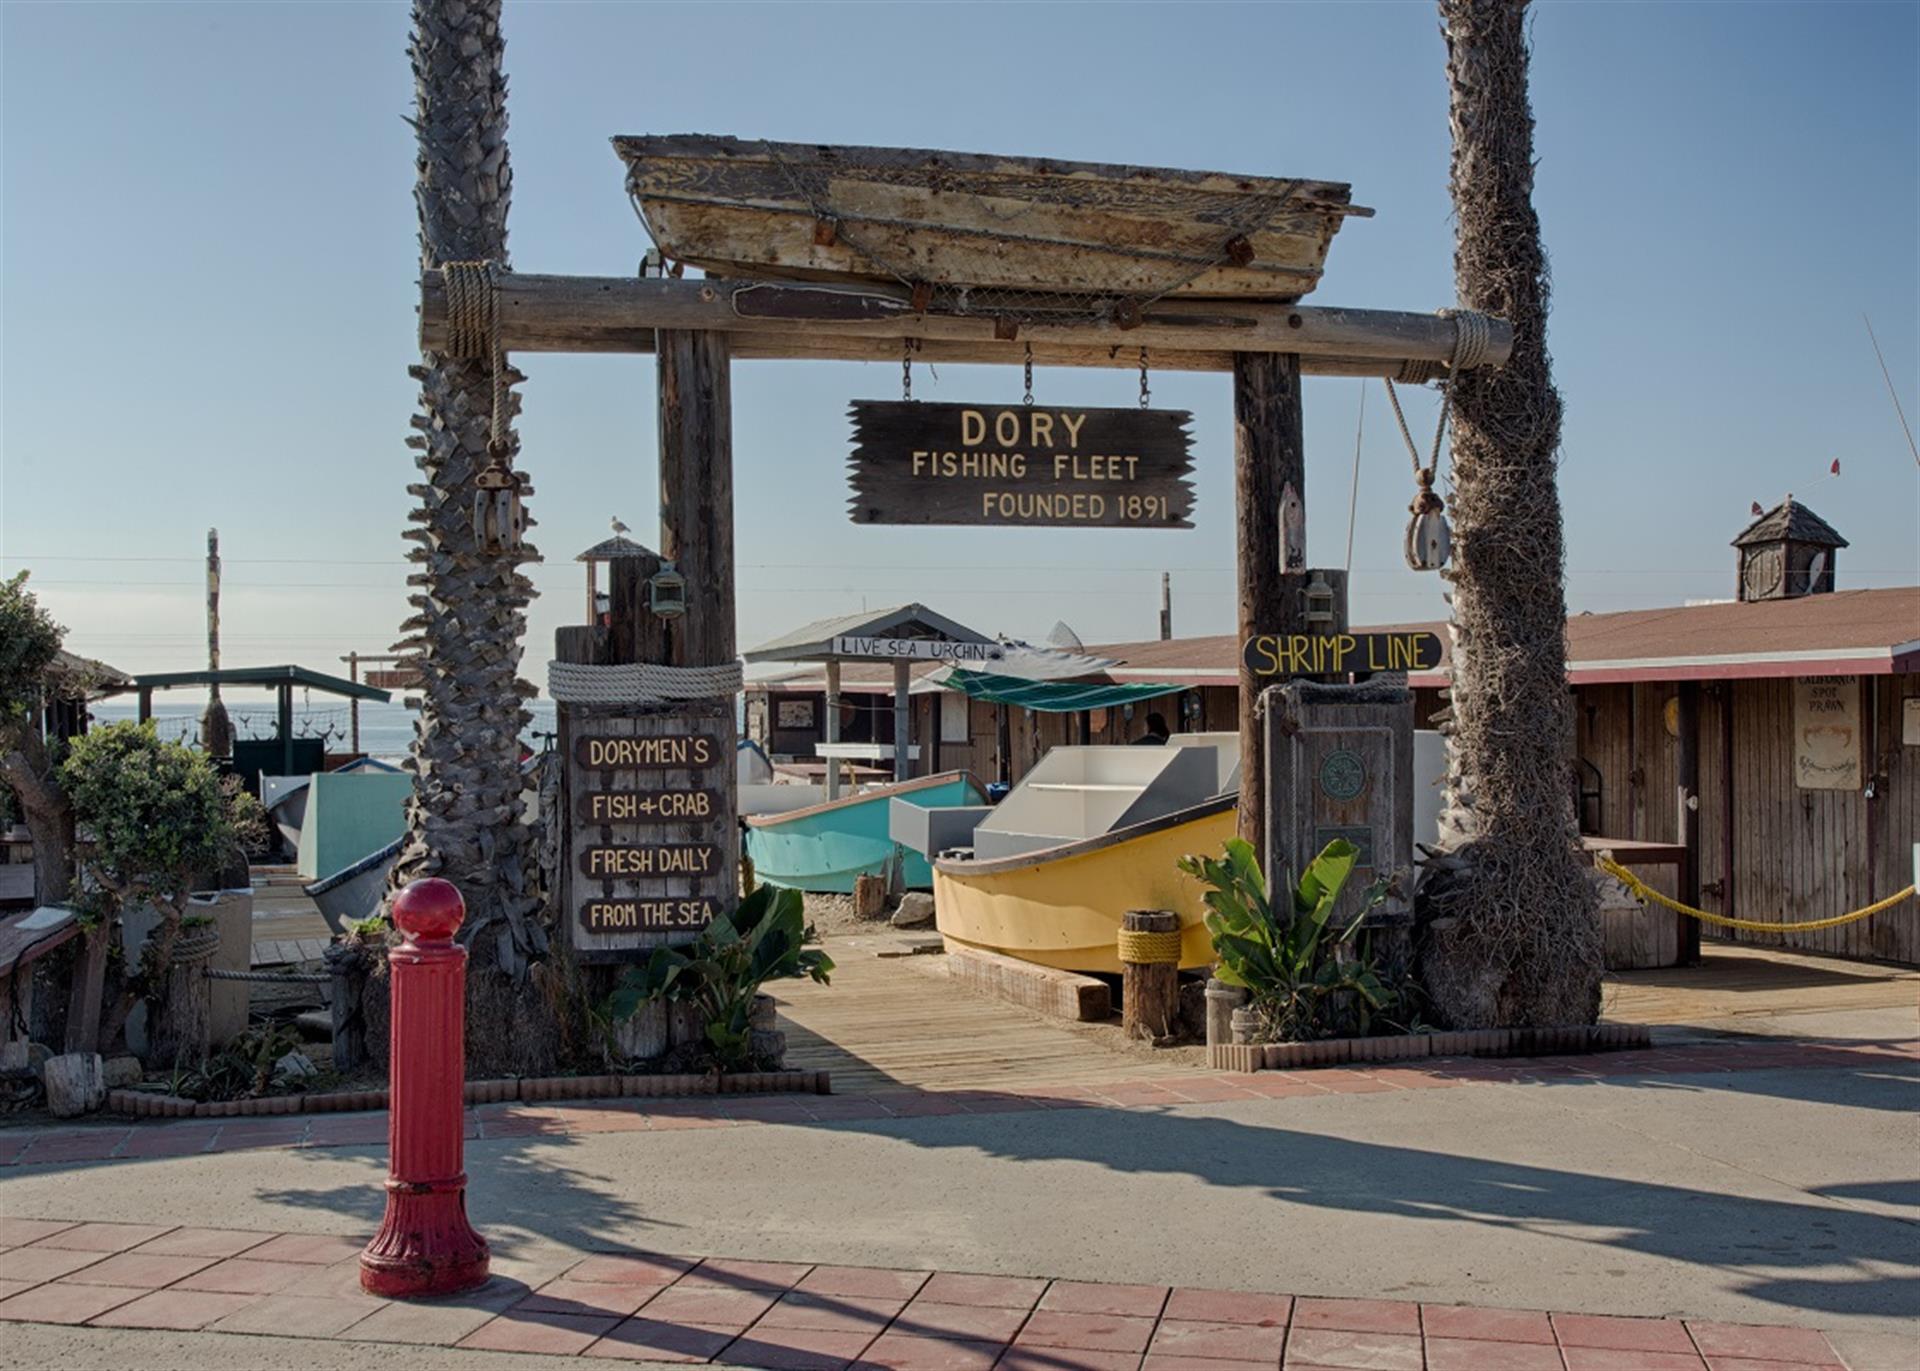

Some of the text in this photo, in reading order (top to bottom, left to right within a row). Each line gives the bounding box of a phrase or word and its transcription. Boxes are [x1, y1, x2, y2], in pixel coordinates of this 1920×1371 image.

[961, 410, 1086, 448] DORY
[912, 451, 1139, 480] FISHING FLEET
[983, 492, 1168, 520] FOUNDED 1891
[841, 637, 986, 660] LIVE SEA URCHIN
[1255, 633, 1430, 675] SHRIMP LINE
[590, 737, 709, 765] DORYMEN'S
[593, 795, 637, 818] FISH
[658, 792, 710, 817] CRAB
[591, 848, 712, 874] FRESH DAILY
[591, 902, 714, 927] FROM THE SEA
